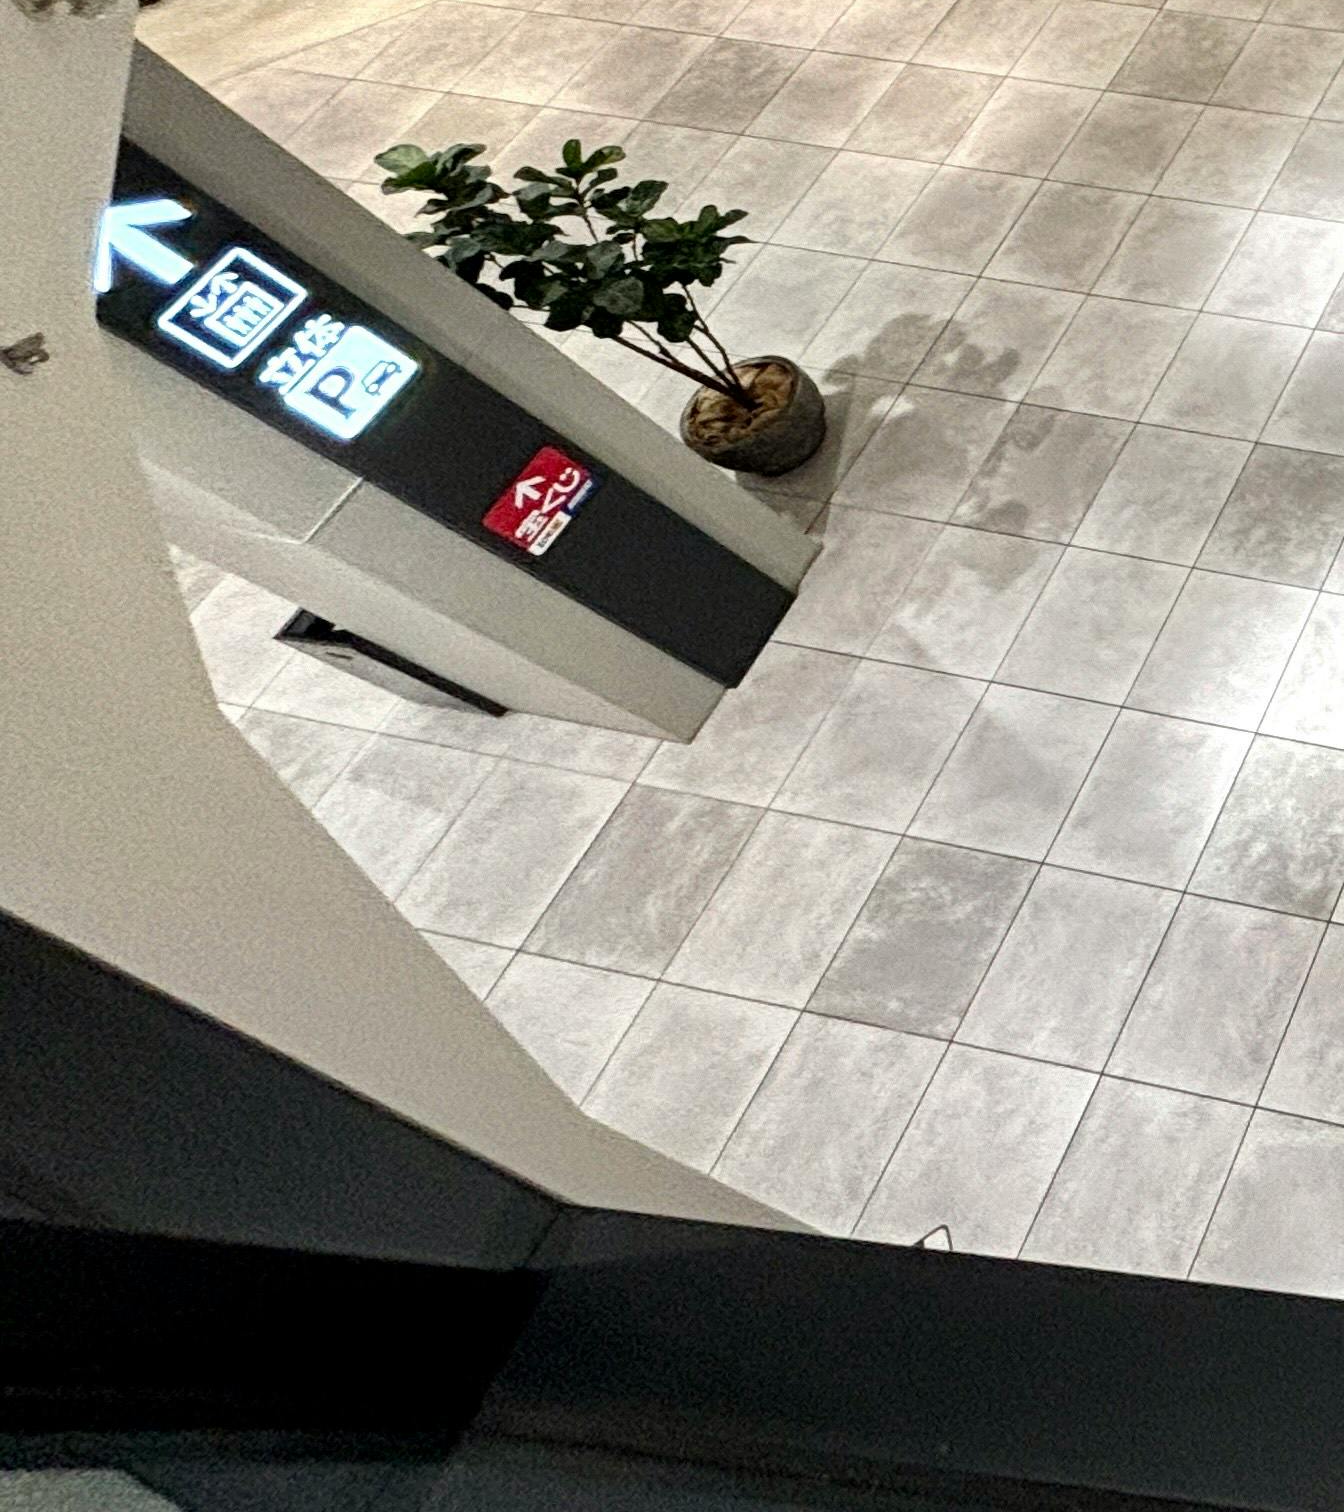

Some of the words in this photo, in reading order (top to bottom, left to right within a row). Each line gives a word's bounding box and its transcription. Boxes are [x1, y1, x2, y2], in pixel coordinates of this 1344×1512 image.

[258, 313, 347, 396] 立体
[304, 365, 356, 419] P
[514, 467, 581, 542] 宝くじ
